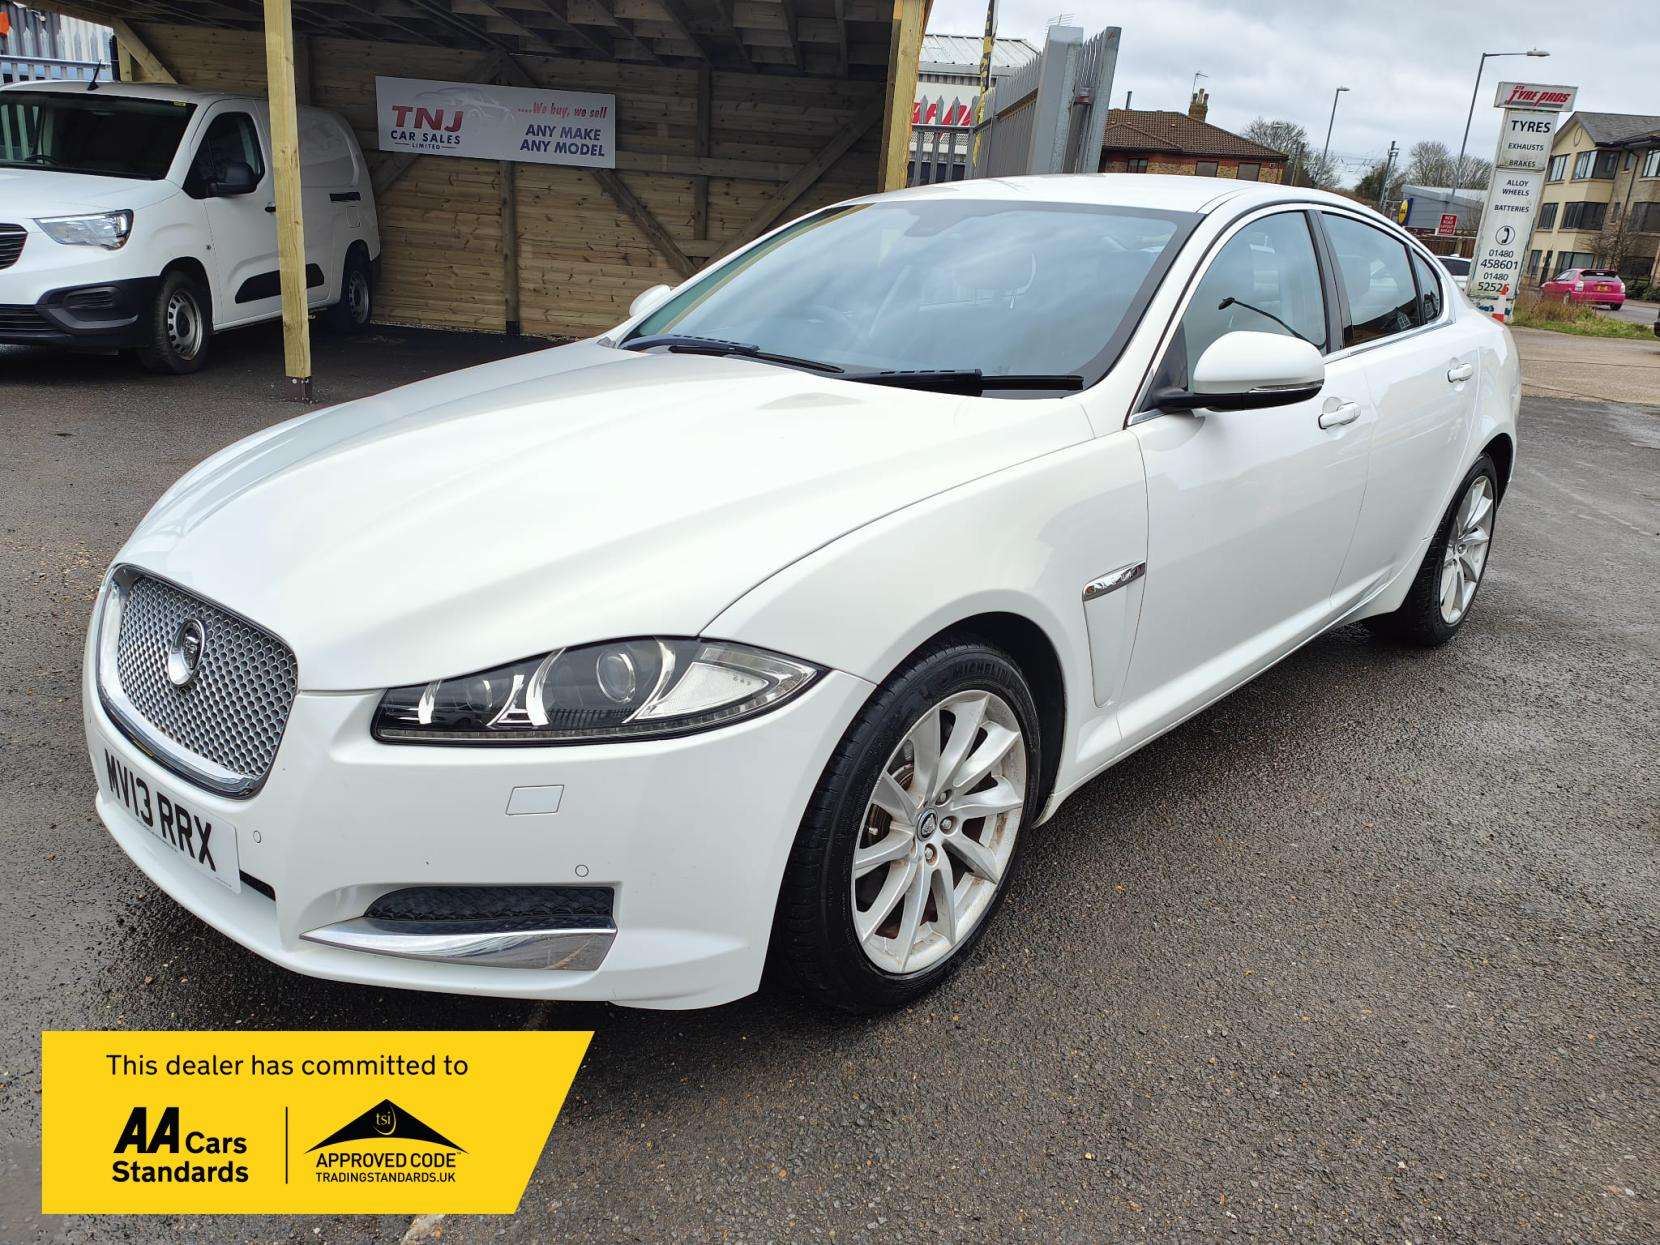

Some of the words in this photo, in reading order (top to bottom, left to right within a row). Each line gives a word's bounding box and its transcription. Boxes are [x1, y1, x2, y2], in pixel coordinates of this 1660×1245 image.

[1507, 90, 1539, 105] TYRE
[551, 104, 570, 119] buy,
[574, 106, 587, 116] we
[587, 105, 608, 119] sell
[392, 105, 464, 133] TNJ
[525, 124, 556, 137] ANY
[560, 126, 601, 141] MAKE
[1511, 120, 1551, 134] TYRES
[390, 130, 416, 141] CAR
[422, 131, 461, 145] SALES
[411, 142, 441, 150] LIMITED
[519, 138, 551, 152] ANY
[554, 141, 605, 156] MODEL
[1507, 142, 1544, 151] EXHAUSTS
[1509, 159, 1536, 168] BRAKES
[1506, 179, 1529, 187] ALLOY
[1502, 188, 1529, 197] WHEELS
[1494, 204, 1529, 213] BATTERIES
[1488, 249, 1514, 258] 01480
[1480, 259, 1519, 271] 458601
[1483, 272, 1509, 281] 01480
[105, 748, 153, 827] MV13
[157, 791, 216, 872] RRX
